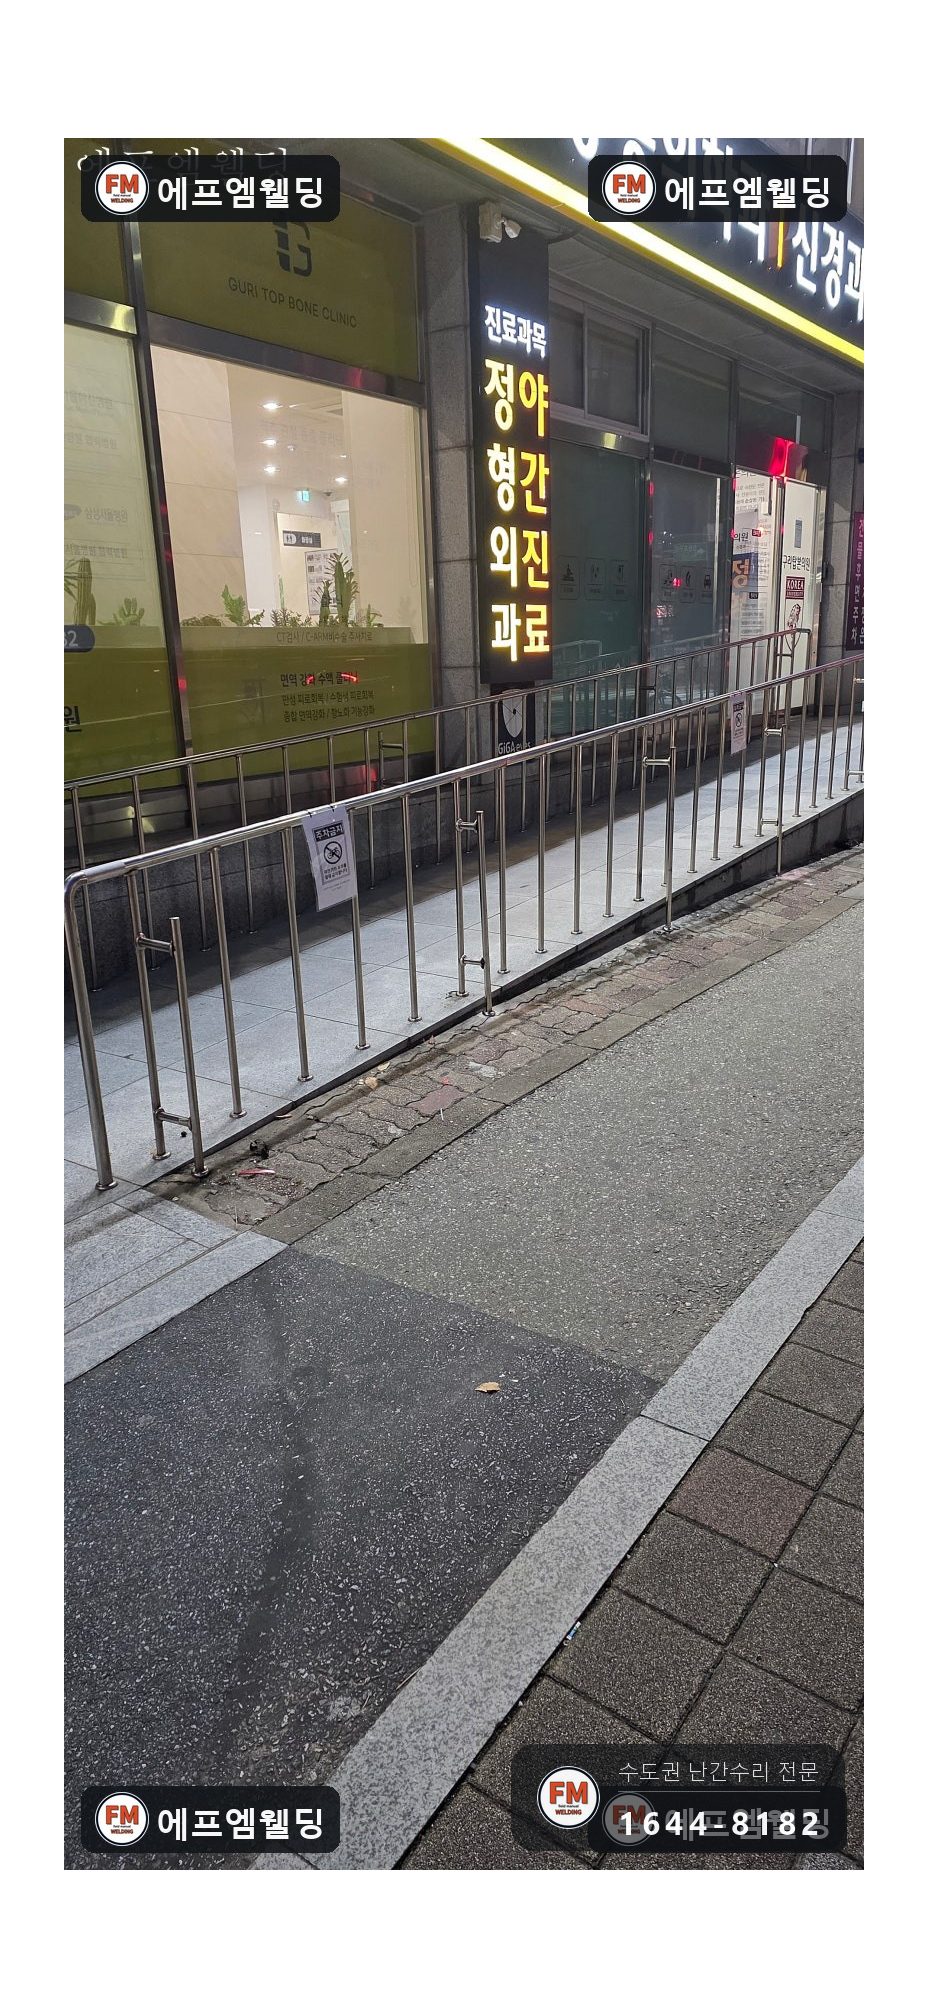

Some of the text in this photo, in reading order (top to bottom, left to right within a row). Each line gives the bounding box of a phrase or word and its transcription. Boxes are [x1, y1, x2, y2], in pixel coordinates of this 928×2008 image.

[228, 277, 358, 328] GURI TOP BONE CLINIC
[484, 304, 547, 358] 진료과목
[484, 358, 521, 662] 정형외과
[518, 370, 550, 654] 야간진료
[786, 579, 804, 590] KOREA
[280, 673, 298, 687] 면역
[315, 824, 344, 840] 주차금지
